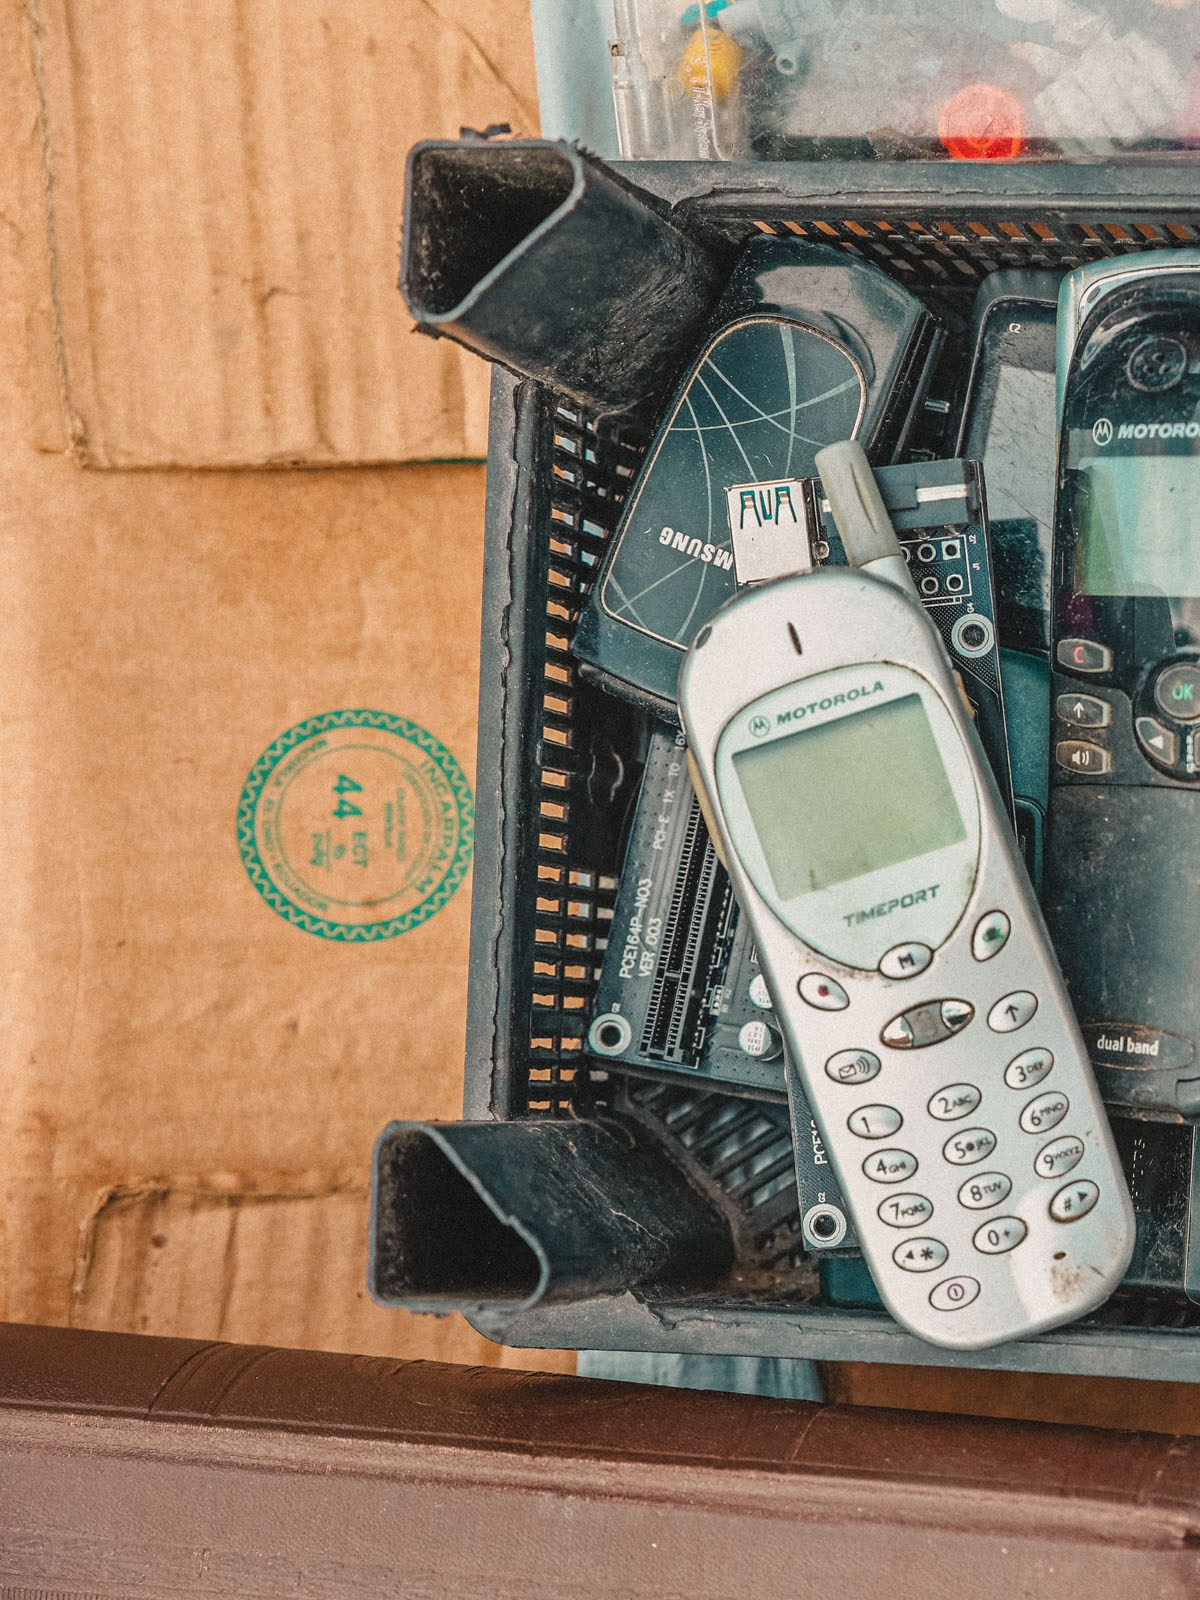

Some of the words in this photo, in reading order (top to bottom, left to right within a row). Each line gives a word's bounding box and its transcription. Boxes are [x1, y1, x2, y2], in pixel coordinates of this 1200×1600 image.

[1073, 646, 1085, 664] C
[776, 681, 884, 725] MOTOROLA
[1171, 683, 1195, 700] OK
[332, 774, 364, 820] 44
[352, 831, 368, 868] ECT
[843, 884, 941, 928] TIMEPORT
[646, 918, 662, 946] 003
[639, 951, 655, 977] VER
[1097, 1035, 1123, 1052] dual
[1127, 1037, 1159, 1056] band
[861, 1116, 870, 1133] 1
